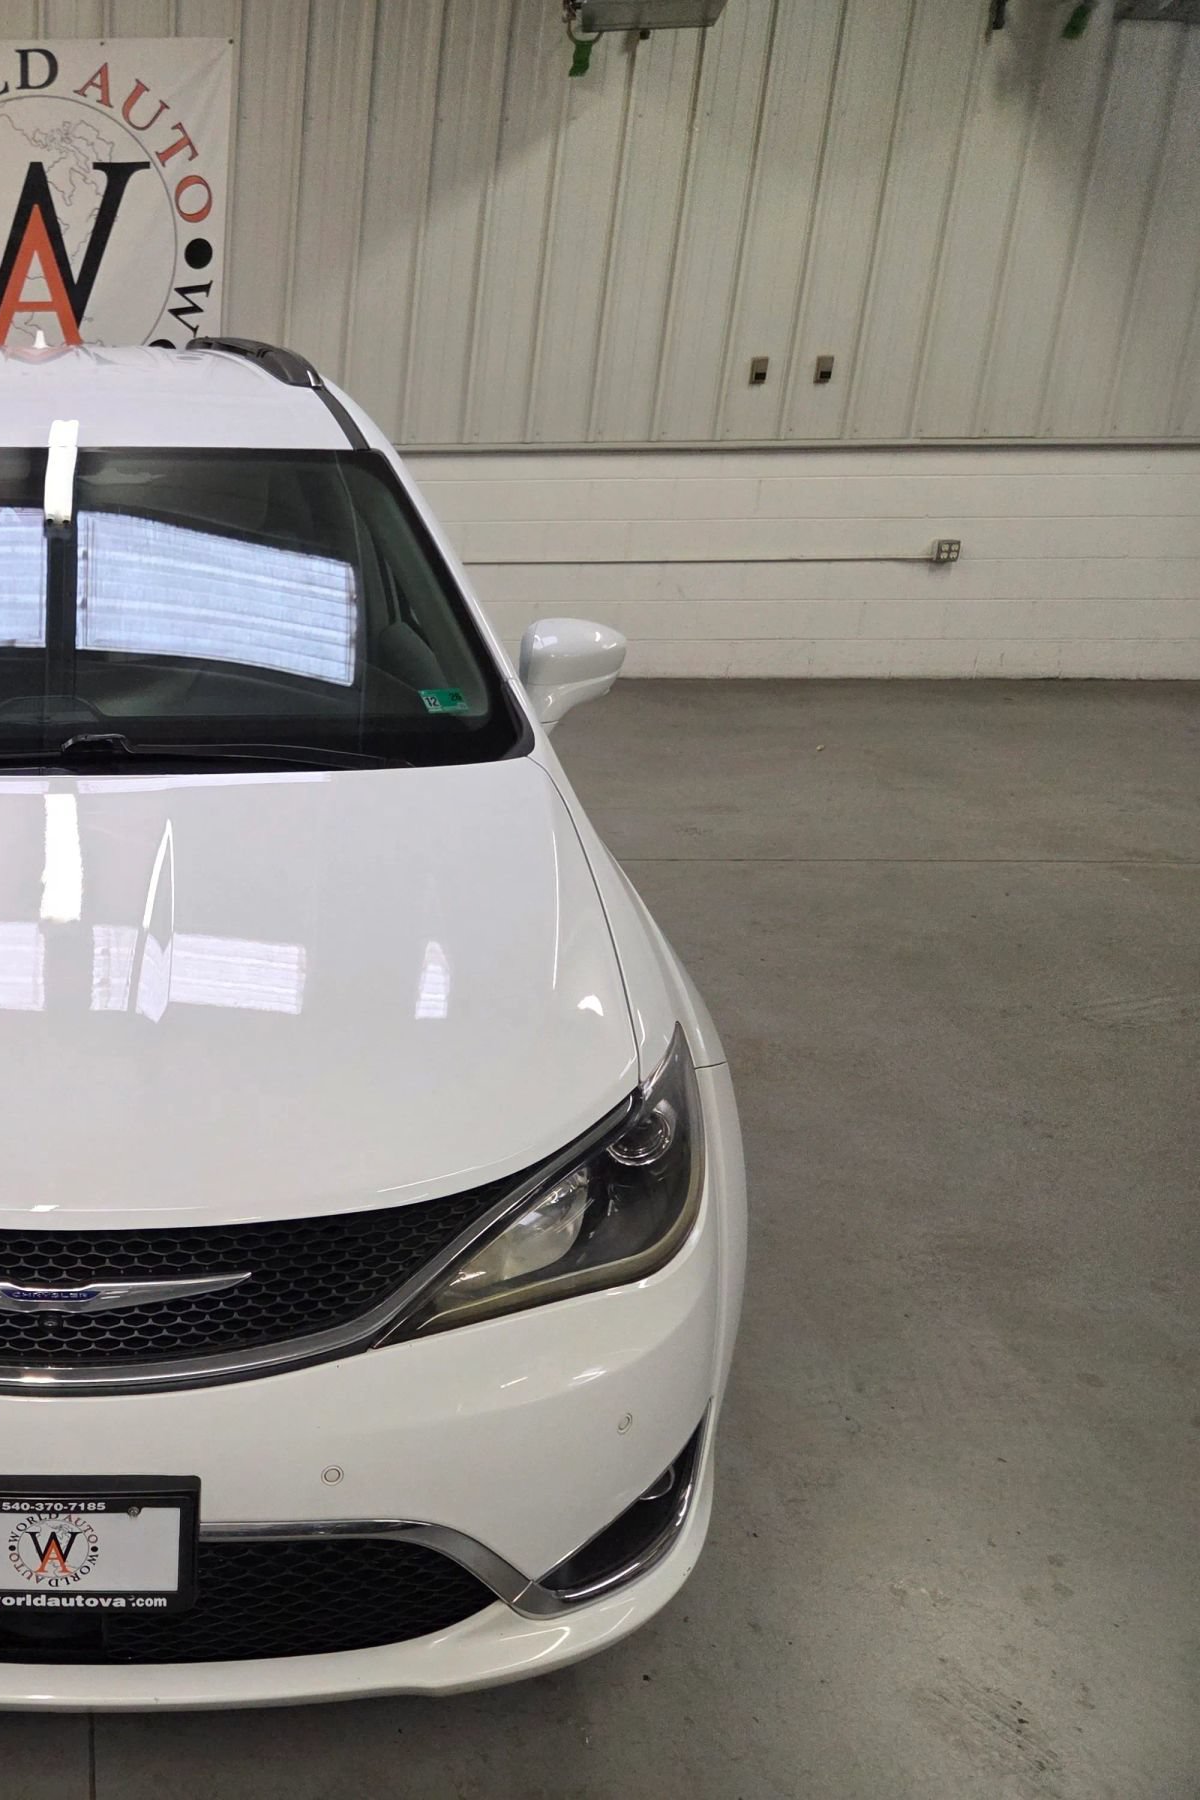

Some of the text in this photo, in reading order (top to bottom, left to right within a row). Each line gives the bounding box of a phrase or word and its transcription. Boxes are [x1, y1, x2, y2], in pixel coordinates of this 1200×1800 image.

[73, 62, 212, 223] AUTO
[12, 1291, 87, 1299] CHRYSLER
[1, 1502, 106, 1511] 540-370-7185
[8, 1513, 99, 1544] WORLD AUTO
[9, 1552, 99, 1587] WORLD AUTO
